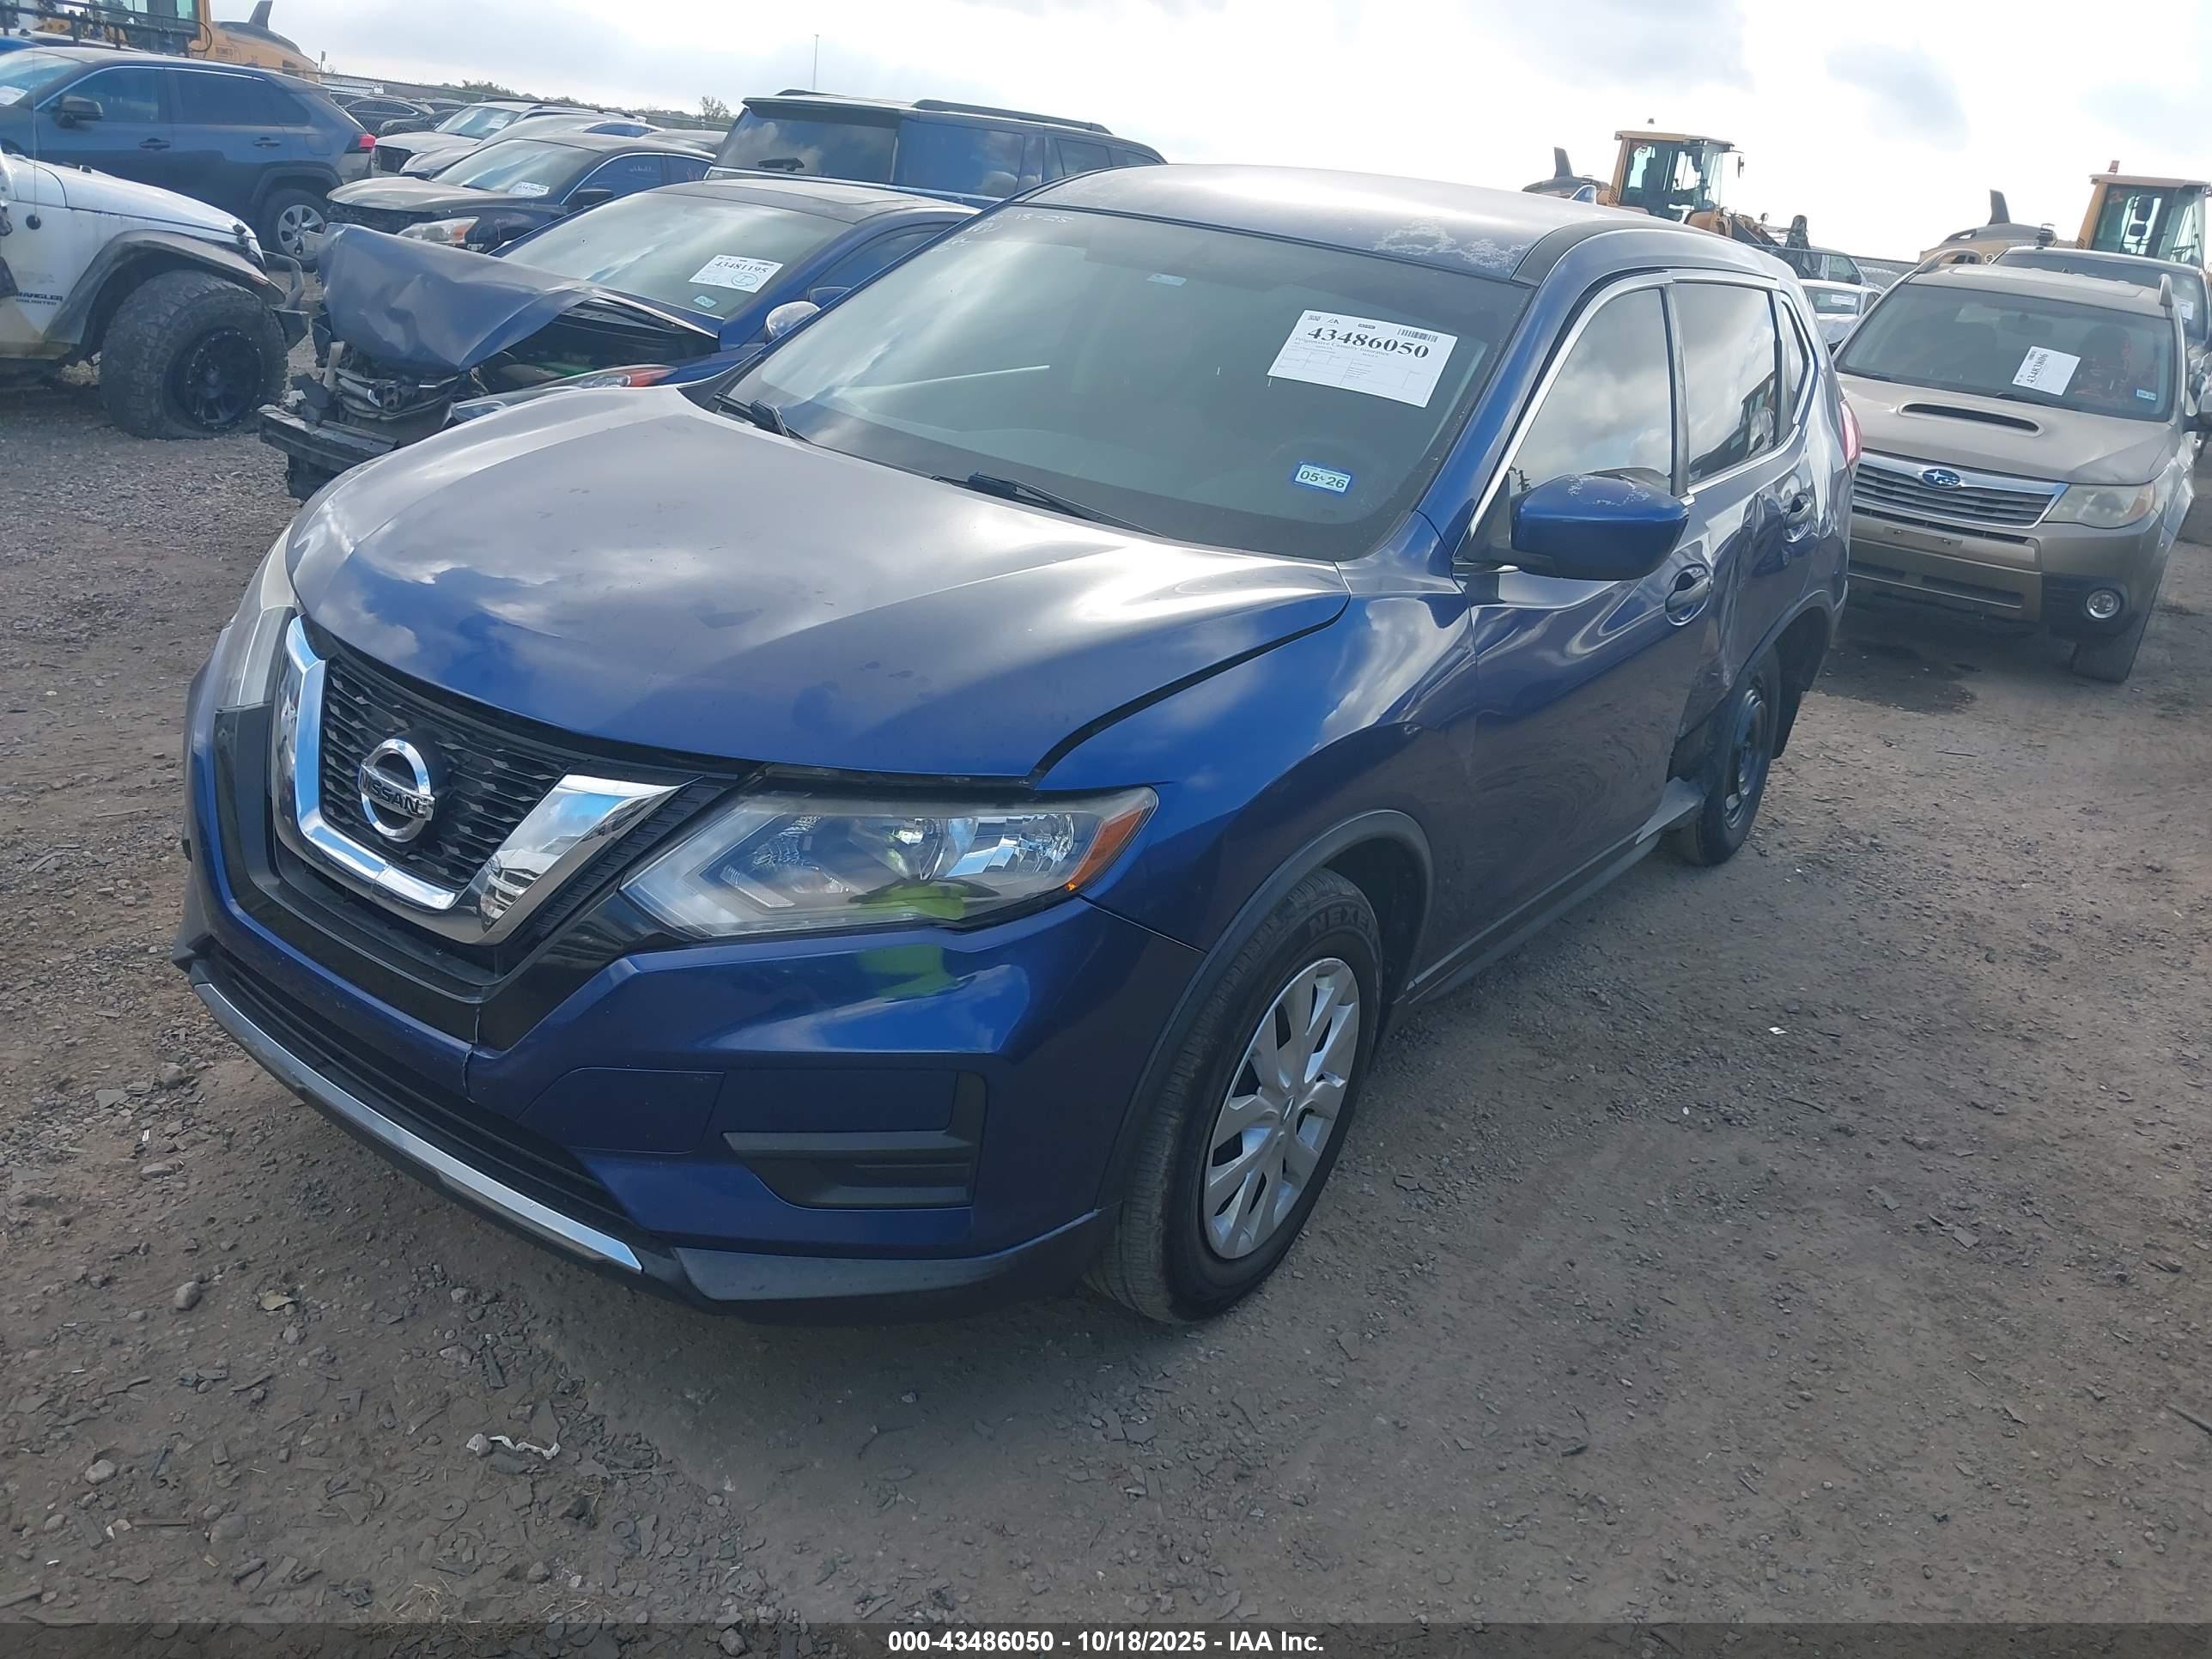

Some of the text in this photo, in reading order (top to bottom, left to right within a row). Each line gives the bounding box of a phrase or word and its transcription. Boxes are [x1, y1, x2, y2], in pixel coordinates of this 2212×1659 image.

[1308, 326, 1430, 359] 43486050
[1300, 471, 1346, 488] 05 26
[361, 769, 420, 813] NISSAN
